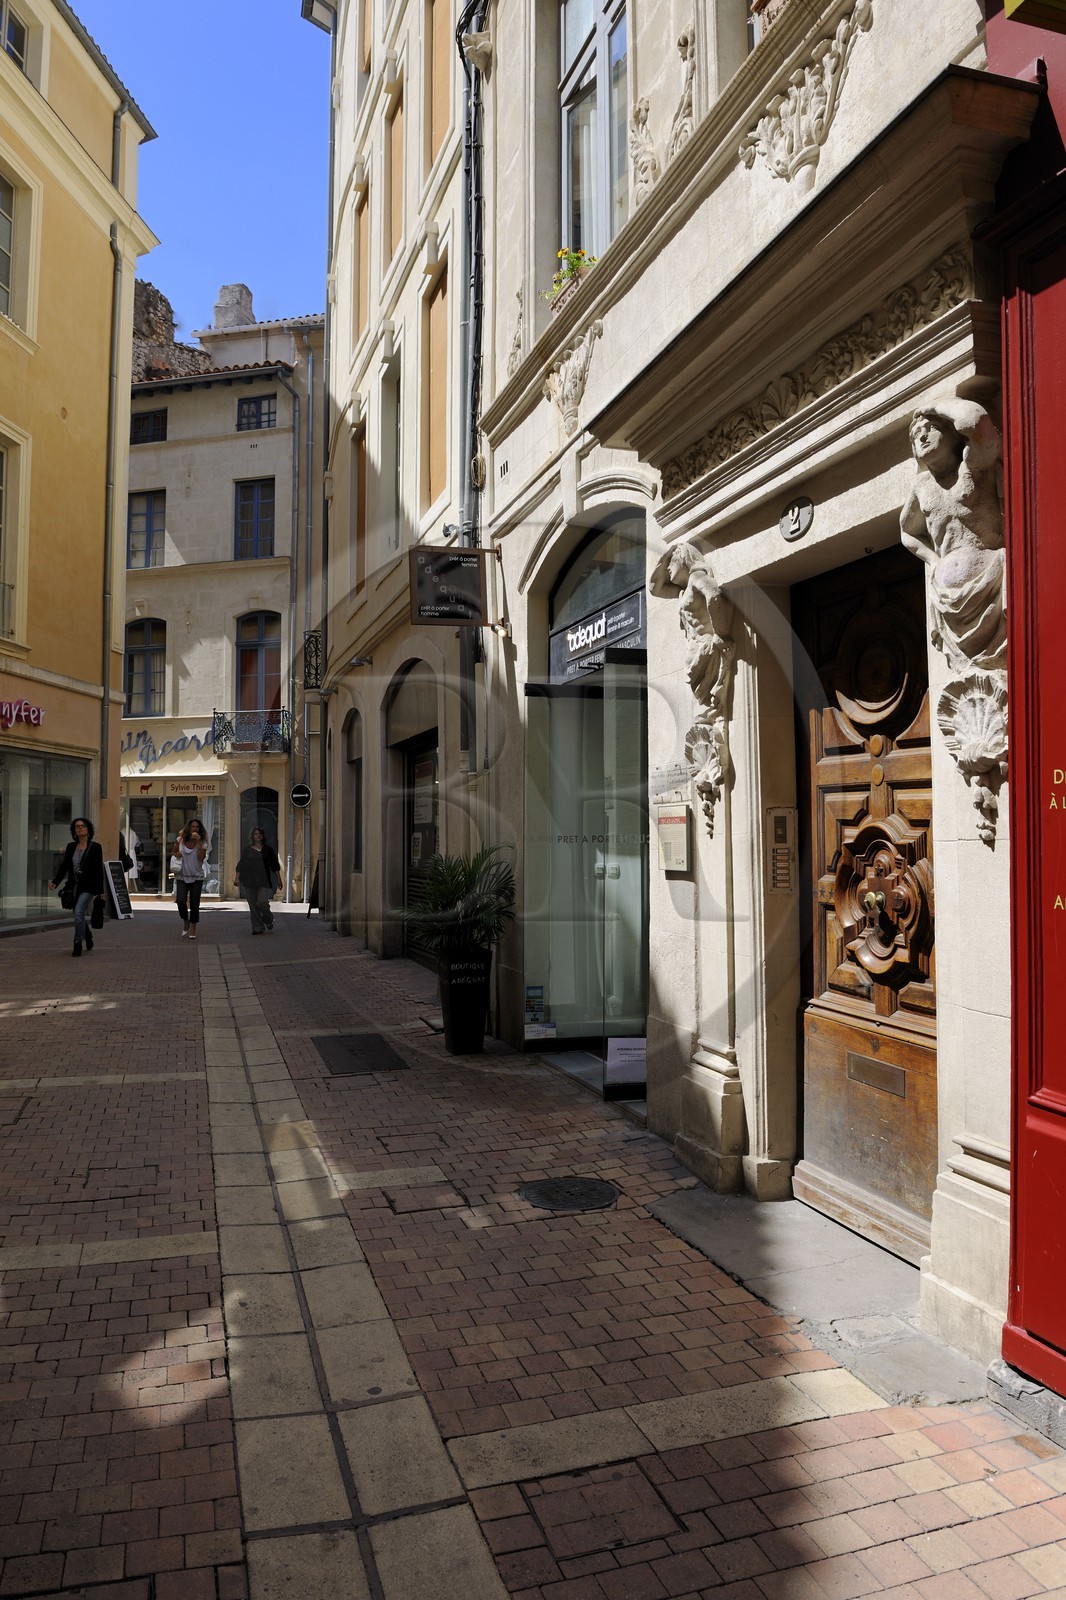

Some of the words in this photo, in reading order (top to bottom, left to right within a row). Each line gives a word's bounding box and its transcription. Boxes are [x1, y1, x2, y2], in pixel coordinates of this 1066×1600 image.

[788, 505, 801, 535] 2
[568, 612, 606, 653] adequat
[170, 783, 190, 793] Sylvie
[191, 783, 216, 791] Thiriez
[1049, 792, 1058, 810] À
[557, 835, 579, 844] PRET
[581, 835, 588, 844] A
[450, 962, 486, 971] BOUTIQUE
